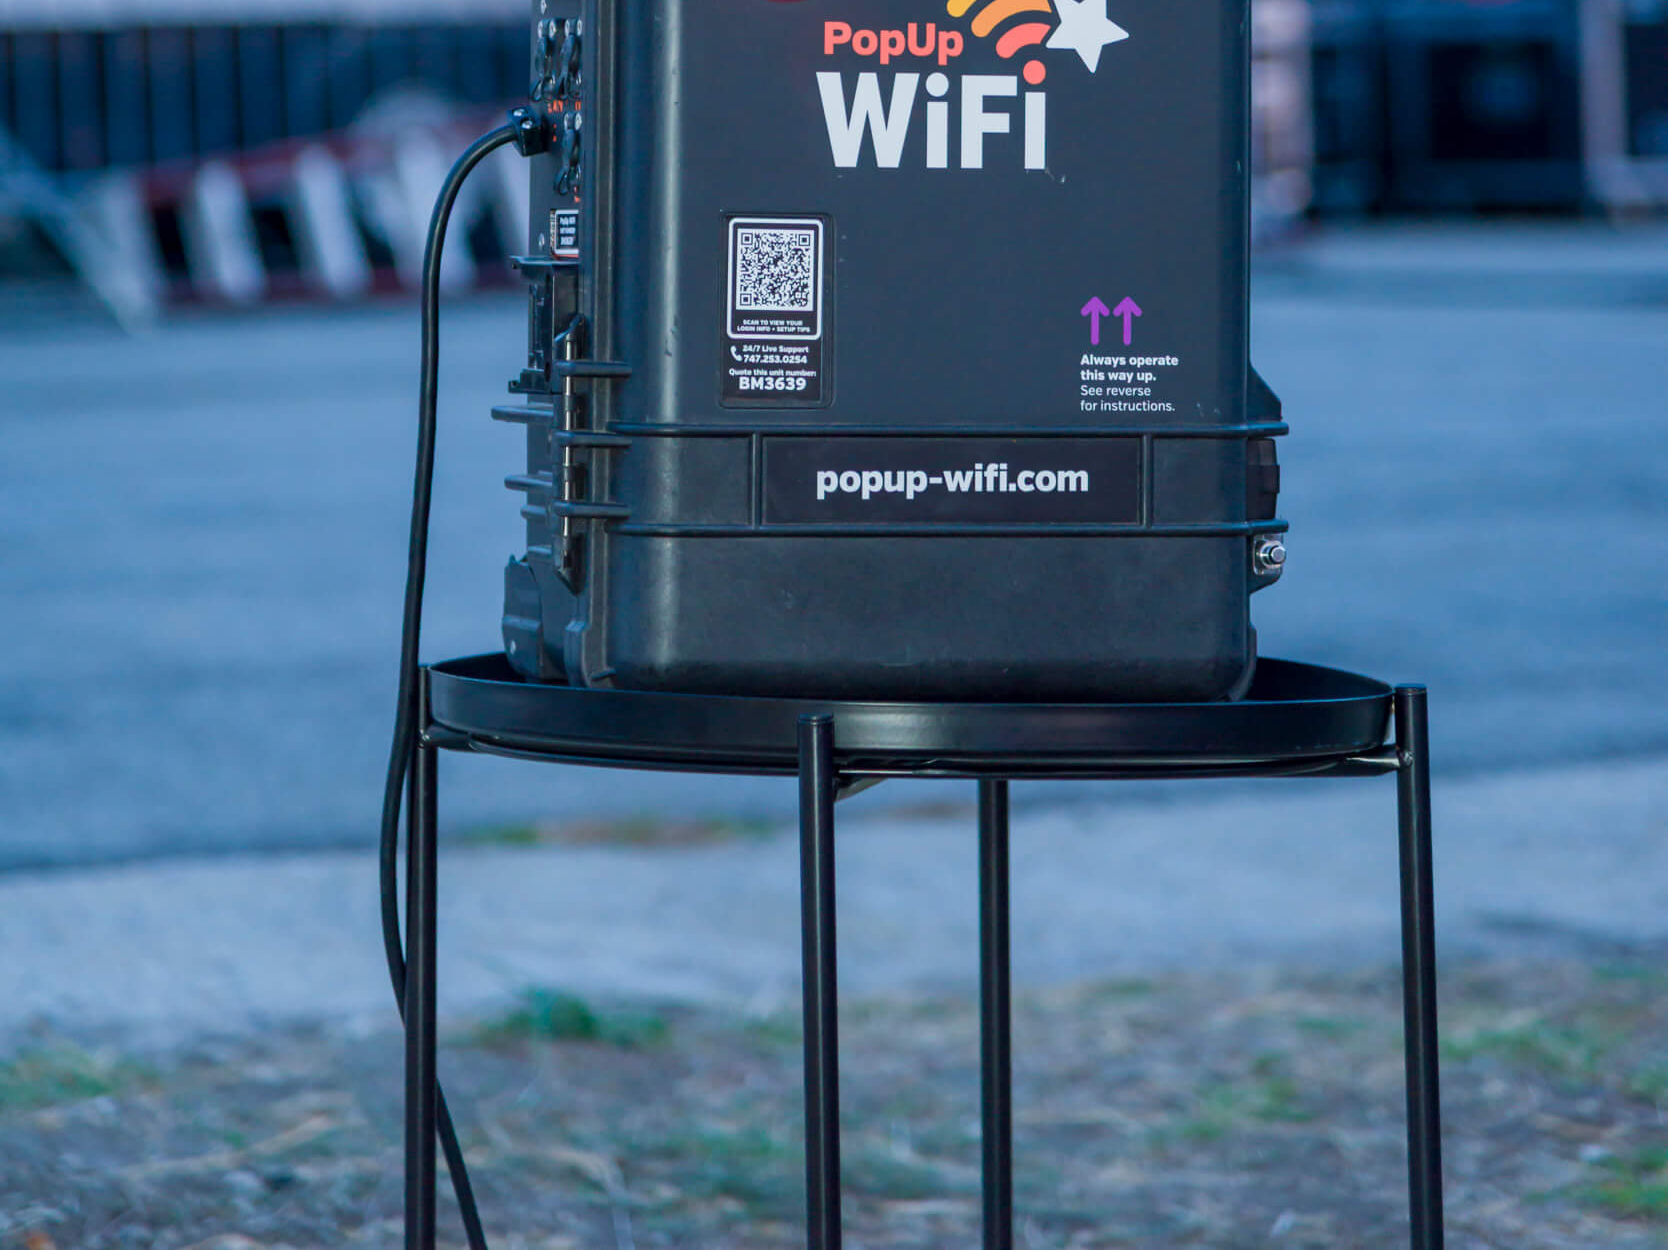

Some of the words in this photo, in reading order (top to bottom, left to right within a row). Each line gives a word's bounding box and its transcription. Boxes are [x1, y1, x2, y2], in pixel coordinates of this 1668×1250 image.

[824, 21, 964, 66] PopUp
[816, 60, 1047, 170] WiFi
[779, 346, 809, 354] Support
[744, 354, 808, 364] 747.253.0254
[1080, 354, 1126, 368] Always
[1128, 355, 1179, 368] operate
[729, 368, 752, 377] Quote
[753, 368, 768, 376] this
[1080, 369, 1105, 381] this
[1107, 371, 1134, 383] way
[1136, 371, 1157, 383] up.
[739, 376, 807, 391] BM3639
[1080, 384, 1103, 396] See
[1106, 387, 1151, 396] reverse
[1080, 399, 1098, 411] for
[1100, 400, 1176, 411] instructions.
[816, 463, 1089, 500] popup-wifi.com
